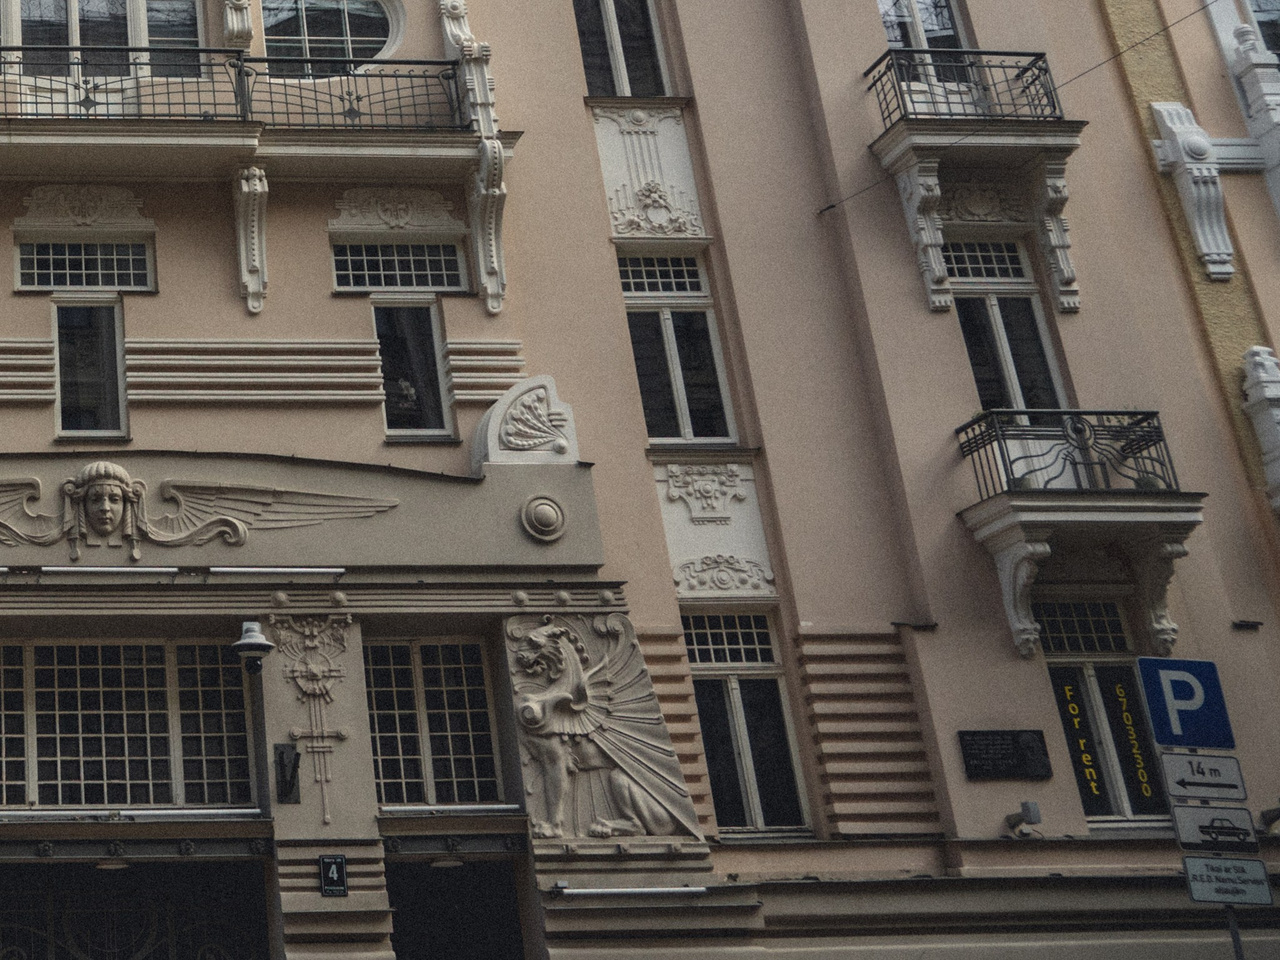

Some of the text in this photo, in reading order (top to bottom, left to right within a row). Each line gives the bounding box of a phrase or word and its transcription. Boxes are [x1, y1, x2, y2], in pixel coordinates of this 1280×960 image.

[1159, 669, 1205, 735] P
[1064, 686, 1100, 795] For rent
[1116, 684, 1151, 797] 67032300
[1187, 761, 1221, 778] 14 m
[329, 864, 338, 881] 4
